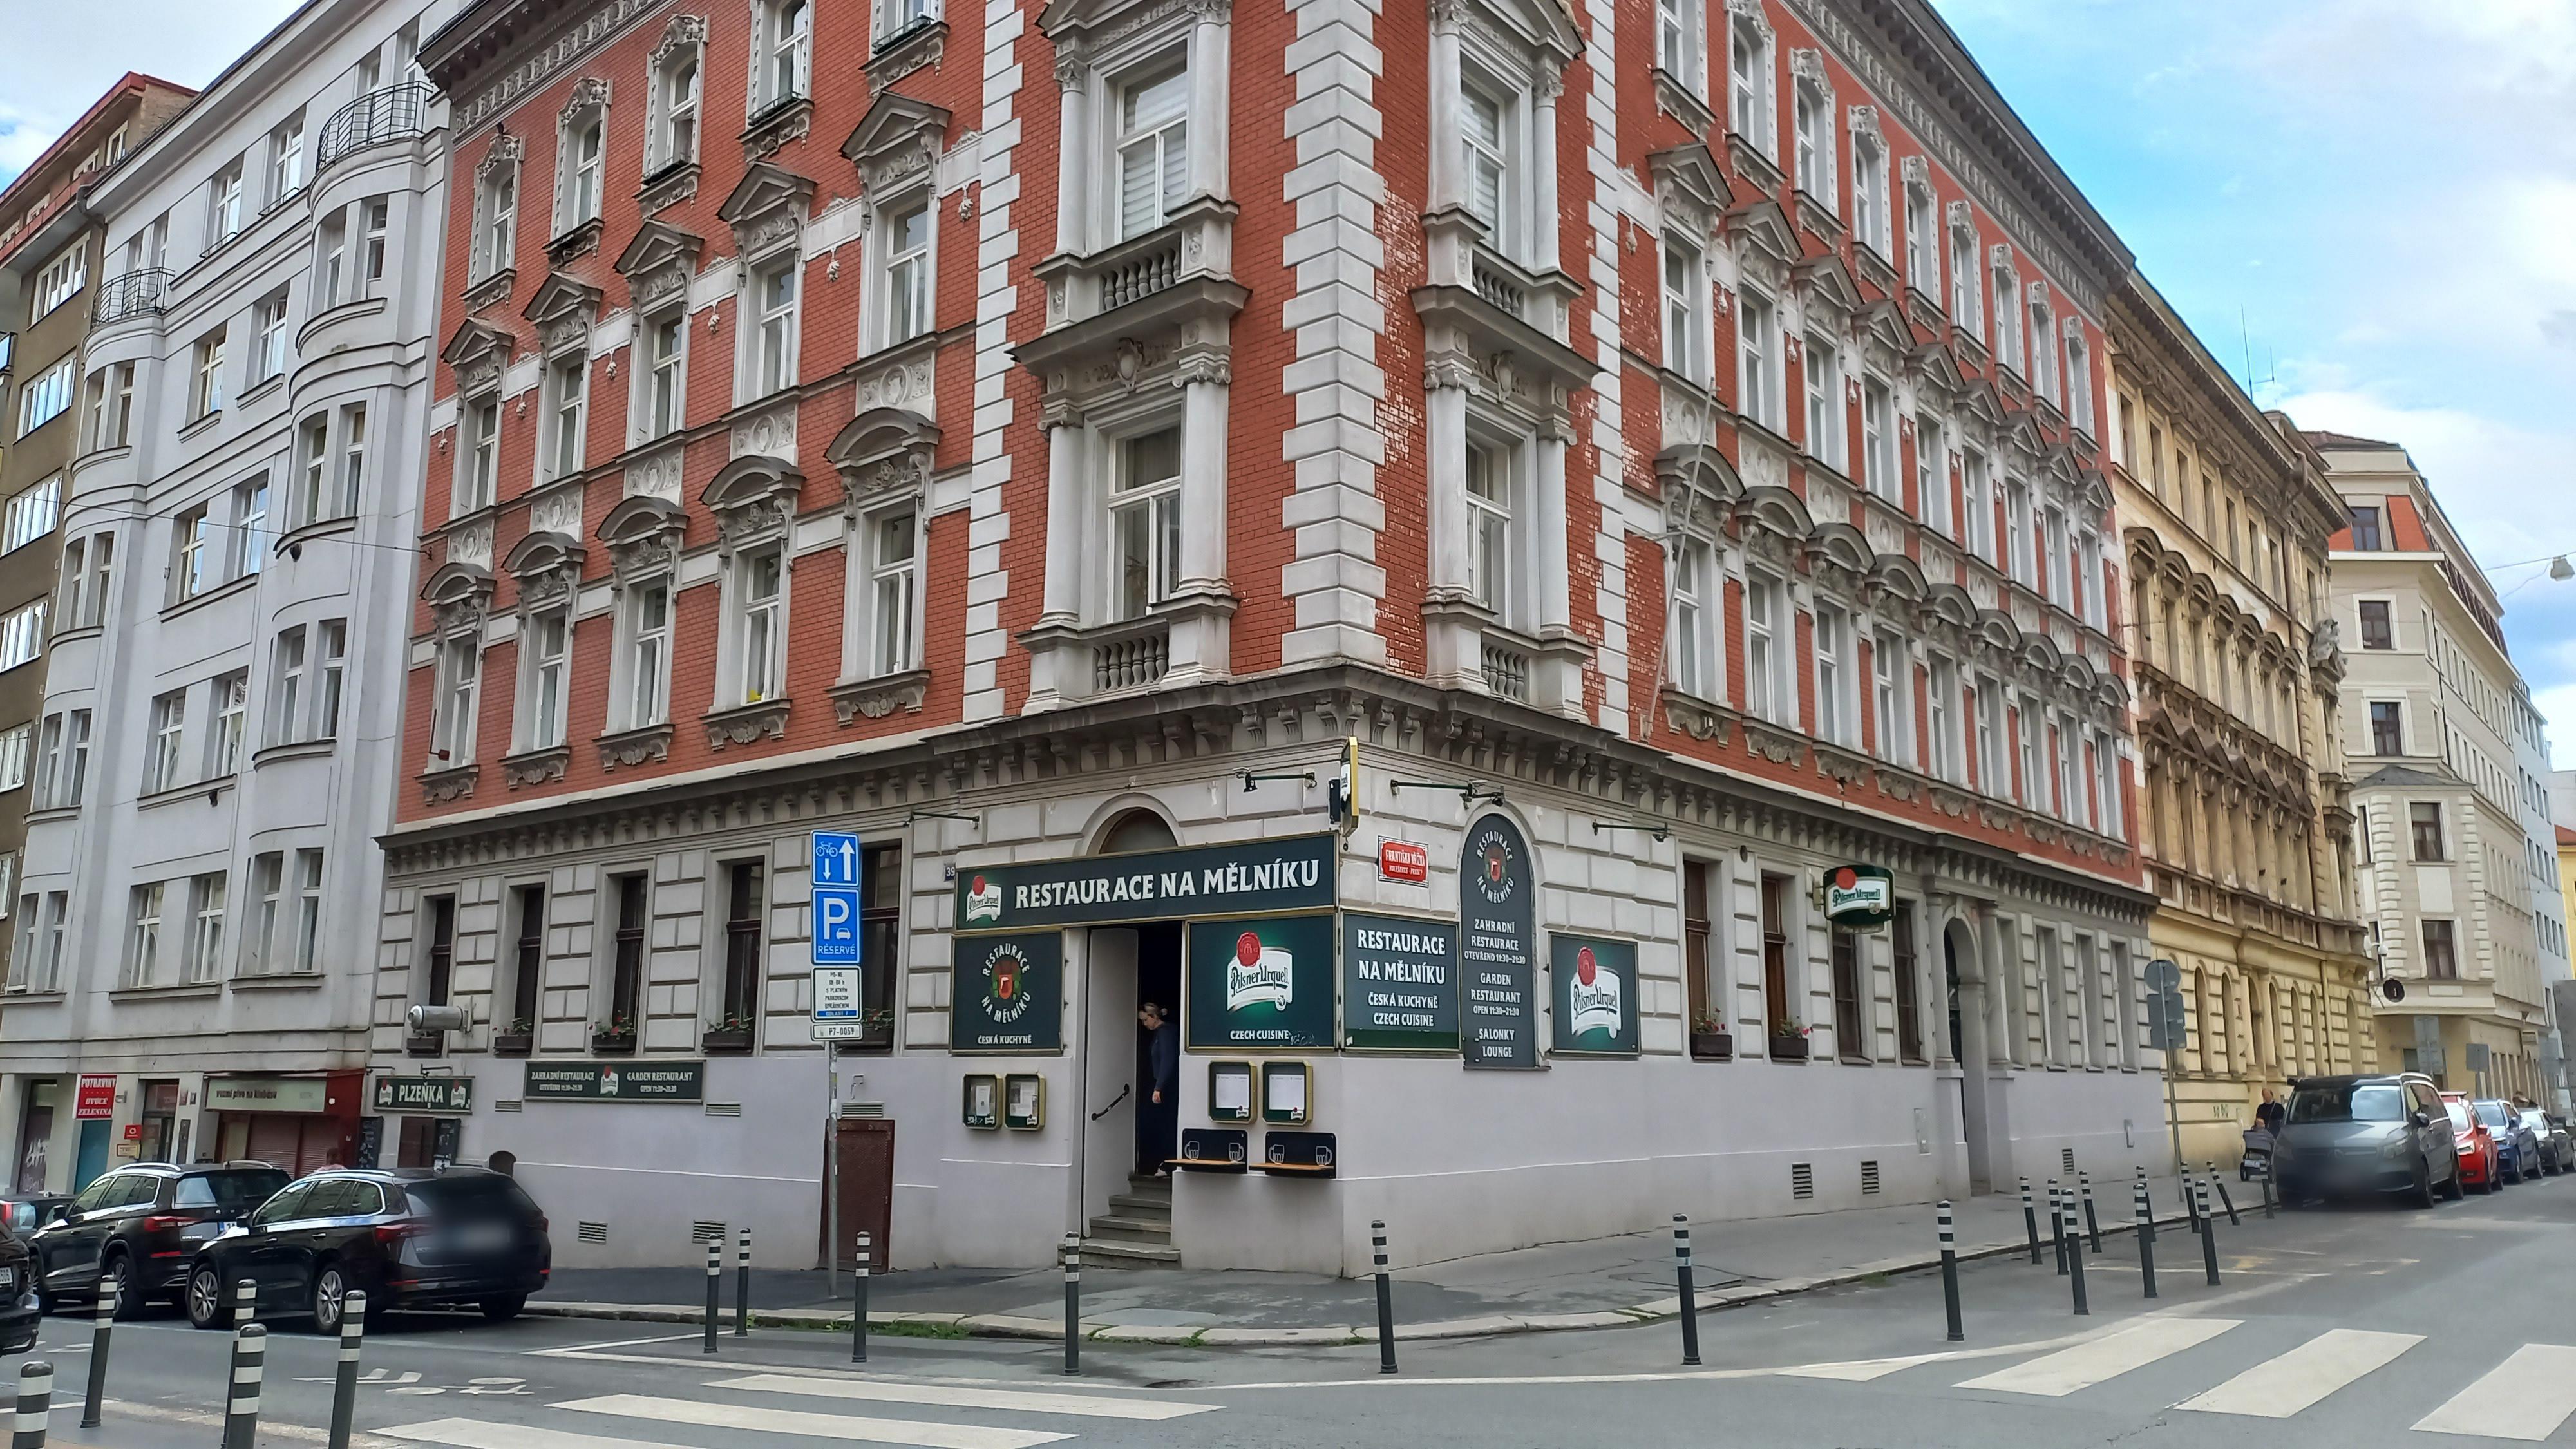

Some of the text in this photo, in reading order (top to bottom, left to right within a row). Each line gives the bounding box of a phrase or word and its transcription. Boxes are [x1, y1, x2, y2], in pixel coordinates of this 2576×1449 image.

[1477, 830, 1513, 862] RESTAURACE
[946, 867, 955, 876] 39
[1014, 857, 1320, 909] RESTAURACE NA MĚLNÍKU
[1477, 875, 1514, 904] NA MĚLNÍKU
[1832, 887, 1880, 907] Pilsner Urquell
[823, 897, 849, 940] P
[1474, 918, 1515, 934] ZAHRADNÍ
[817, 943, 855, 954] RÉSERVÉ
[1357, 929, 1446, 956] RESTAURACE
[1471, 935, 1519, 951] RESTAURACE
[982, 943, 1030, 977] RESTAURACE
[1464, 951, 1495, 961] OTEVŘENO
[1358, 959, 1446, 985] NA MĚLNÍKU
[1480, 972, 1512, 986] GARDEN
[1231, 963, 1289, 998] Pilsner Urquell
[1368, 991, 1439, 1009] ČESKÁ KUCHYNĚ
[1470, 989, 1521, 1003] RESTAURANT
[1573, 983, 1618, 1020] Pilsner Urquell
[981, 991, 1031, 1023] NA MĚLNÍKU
[1473, 1005, 1489, 1014] OPEN
[1373, 1012, 1435, 1027] CZECH CUISINE
[978, 1034, 1032, 1045] ČESKÁ KUCHYNĚ
[1230, 1030, 1256, 1040] CZECH
[1256, 1030, 1289, 1040] CUISINE
[1479, 1028, 1515, 1041] SALONKY
[1482, 1045, 1513, 1058] LOUNGE
[81, 1077, 117, 1088] POTRAVINY
[560, 1071, 595, 1081] RESTAURACE
[627, 1071, 694, 1081] GARDEN RESTAURANT
[398, 1081, 444, 1103] PLZEŇKA
